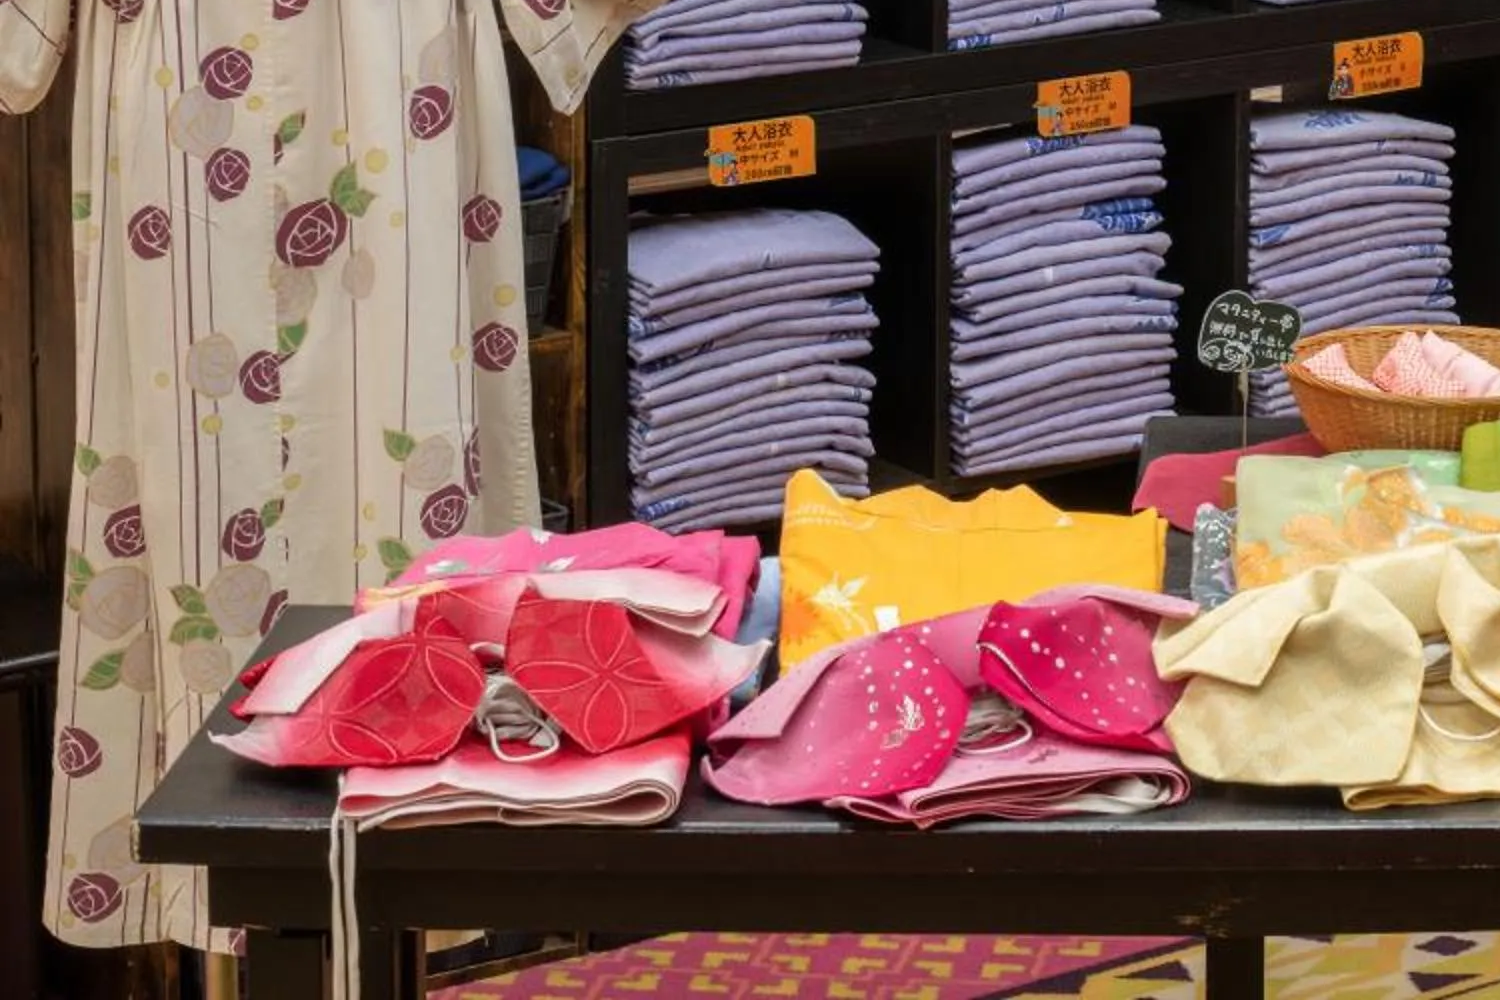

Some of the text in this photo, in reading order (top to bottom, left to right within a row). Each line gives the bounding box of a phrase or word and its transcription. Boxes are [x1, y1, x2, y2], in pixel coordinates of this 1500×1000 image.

[1351, 38, 1402, 60] 大人浴衣
[1058, 76, 1112, 98] 大人浴衣
[732, 120, 793, 145] 大人浴衣
